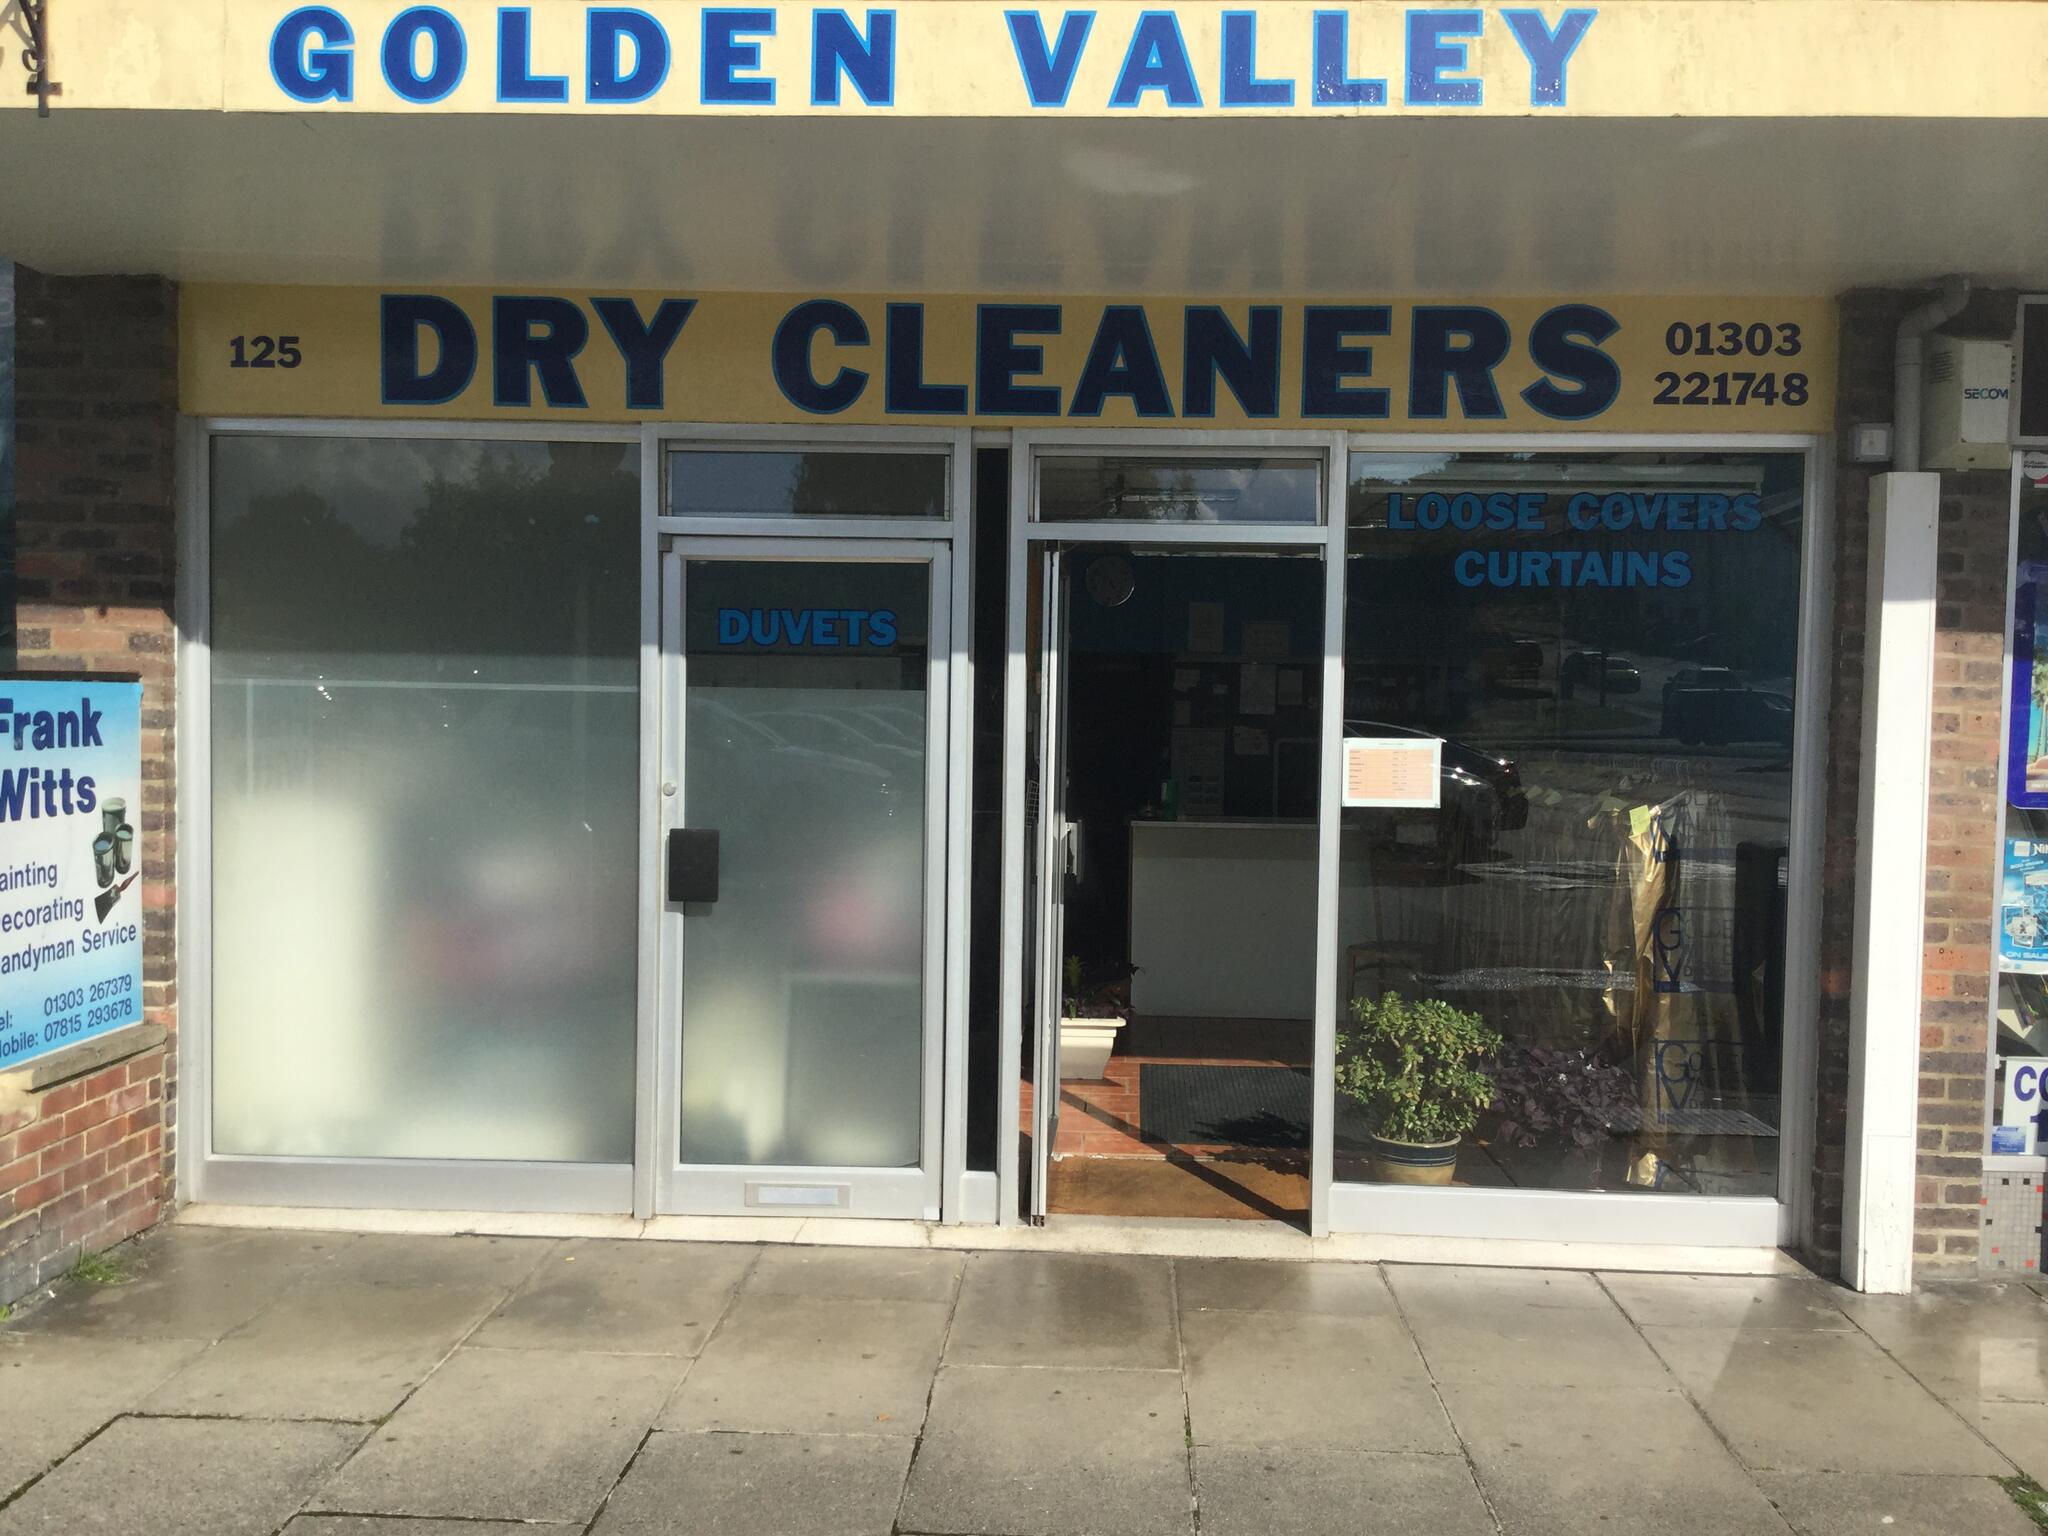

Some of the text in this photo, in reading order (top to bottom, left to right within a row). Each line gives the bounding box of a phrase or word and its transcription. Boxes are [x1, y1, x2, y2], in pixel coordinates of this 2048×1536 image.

[269, 5, 1598, 109] GOLDEN VALLEY
[229, 336, 302, 369] 125
[380, 294, 1622, 421] DRY CLEANERS
[1665, 322, 1802, 357] 01303
[1653, 371, 1810, 406] 221748
[1964, 388, 2009, 399] SECOM
[1387, 492, 1763, 532] LOOSE COVERS
[1454, 550, 1693, 588] CURTAINS
[718, 607, 898, 647] DUVETS
[0, 861, 57, 892] ainting
[1, 896, 84, 933] ecorating
[1, 922, 137, 974] andyman Service
[0, 974, 132, 1032] el: 01303 267379
[0, 998, 132, 1058] obile: 07815 293678
